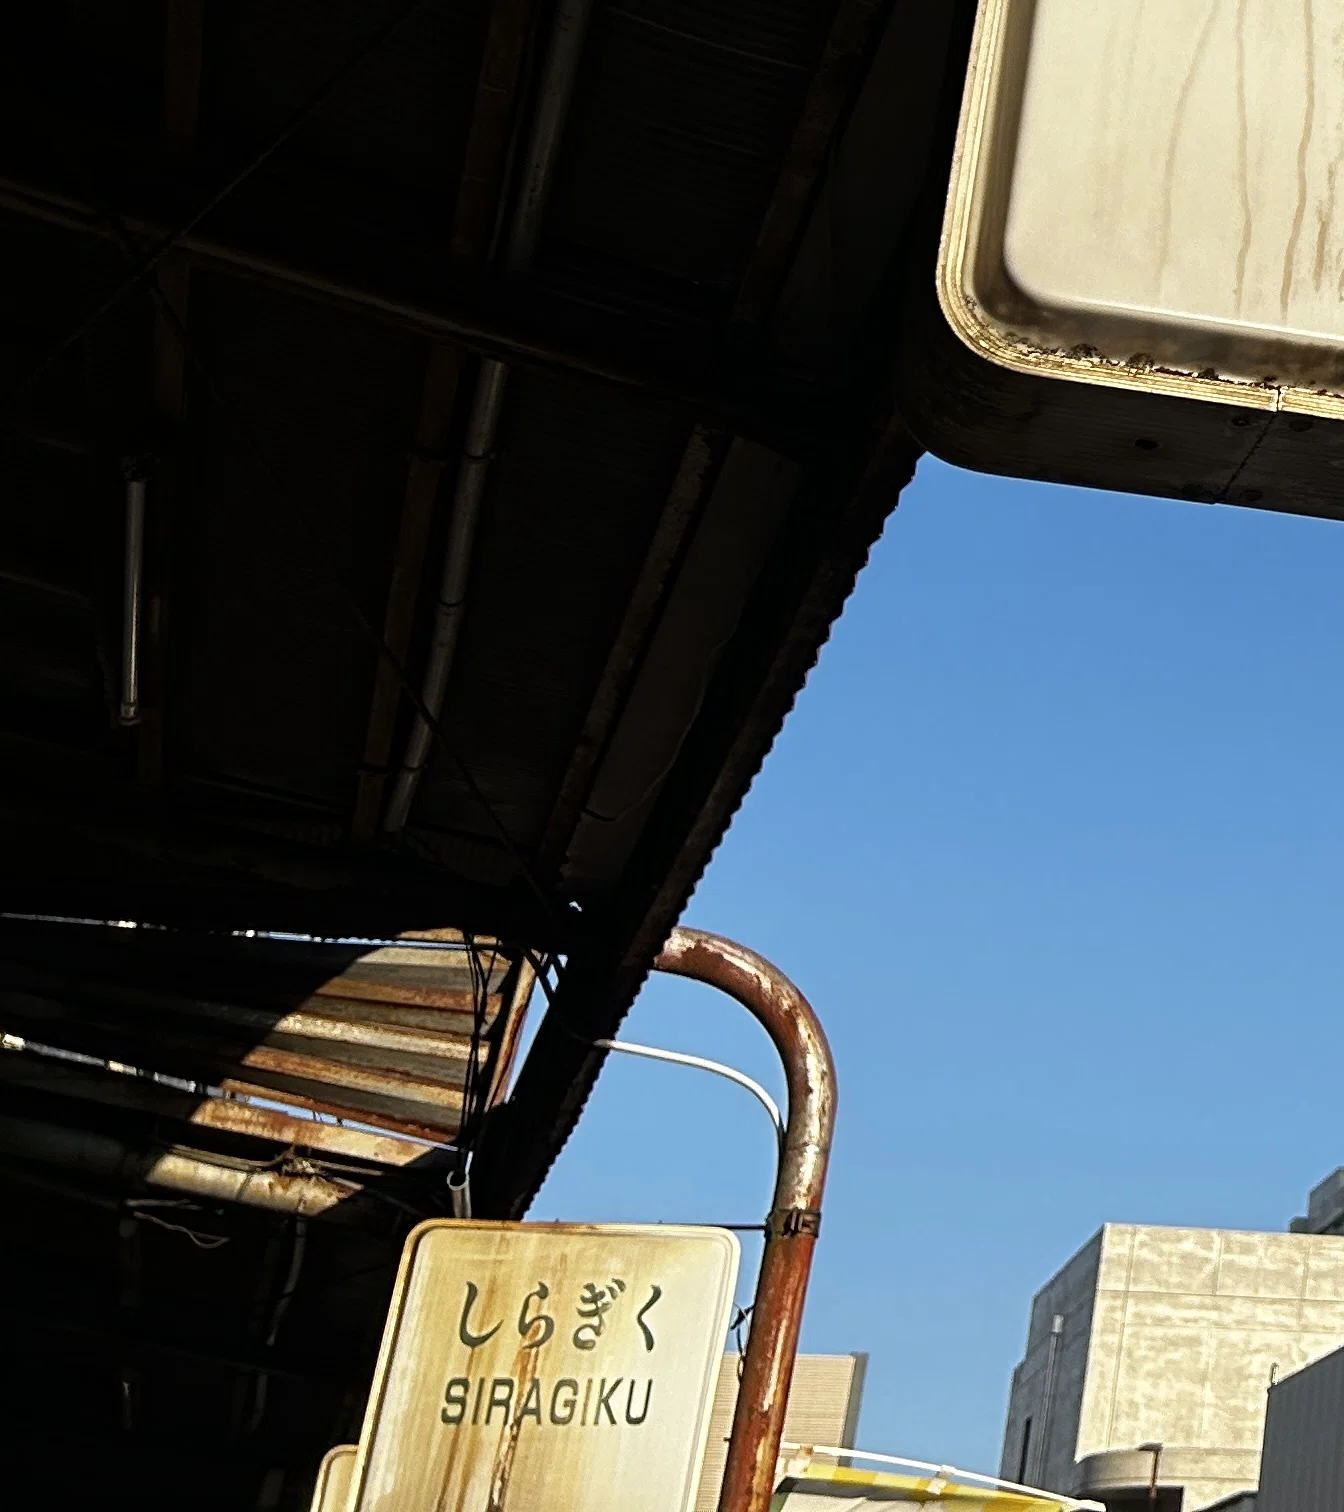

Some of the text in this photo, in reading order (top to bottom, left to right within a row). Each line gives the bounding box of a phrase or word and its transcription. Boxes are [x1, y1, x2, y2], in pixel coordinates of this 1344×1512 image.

[458, 1278, 662, 1352] しらぎく
[440, 1376, 654, 1427] SIRAGIKU
